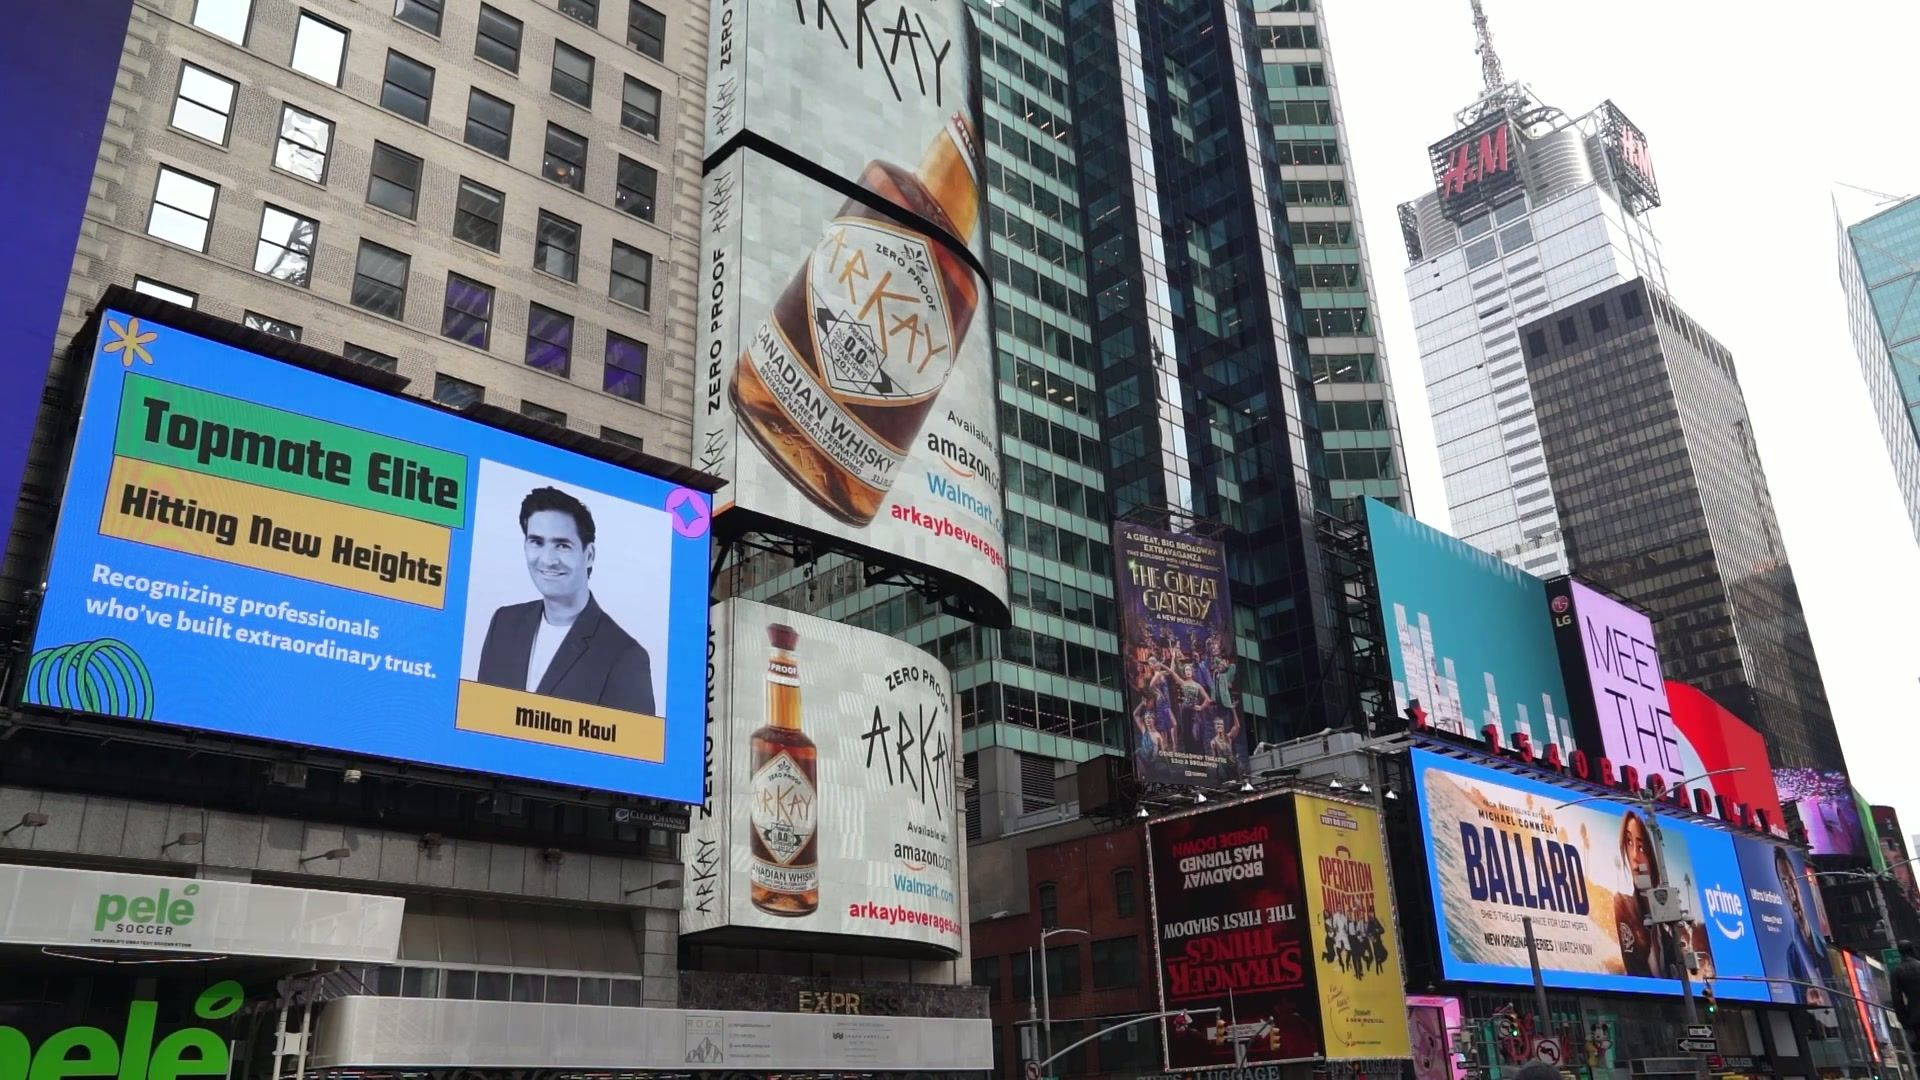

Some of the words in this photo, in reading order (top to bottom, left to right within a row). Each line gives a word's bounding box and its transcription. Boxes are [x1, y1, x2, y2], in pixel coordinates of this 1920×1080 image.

[720, 9, 732, 71] ZERO
[795, 0, 951, 107] KAY
[1442, 124, 1508, 198] H&M
[711, 249, 725, 333] PROOF
[875, 243, 906, 267] ZERO
[907, 267, 937, 312] PROOF
[824, 228, 947, 374] ARKAY
[848, 324, 875, 355] PREMIUM
[708, 339, 722, 416] ZERO
[831, 339, 868, 380] ESTABLISHED
[835, 355, 855, 379] 2011
[757, 324, 828, 421] CANADIAN
[831, 415, 895, 474] WHISKY
[764, 361, 797, 401] ALCOHOL
[795, 399, 815, 422] FREE
[814, 421, 866, 468] ALTERNATIVE
[759, 367, 788, 405] BEVERAGE
[786, 402, 828, 446] NATURALLY
[825, 443, 862, 475] FLAVORED
[947, 410, 993, 451] Available
[142, 396, 352, 487] Topmate
[366, 453, 459, 511] Elite
[700, 428, 728, 476] KAY
[120, 483, 238, 547] Hitting
[249, 514, 321, 560] New
[332, 534, 443, 588] Heights
[1143, 544, 1202, 562] EXTRAVAGANZA
[1161, 539, 1175, 547] BIG
[1176, 541, 1217, 557] BROADWAY
[1130, 564, 1161, 589] THE
[1164, 570, 1217, 599] GREAT
[91, 563, 238, 618] Recognizing
[241, 594, 380, 640] professionals
[1143, 589, 1212, 620] GATSBY
[86, 596, 172, 632] who've
[177, 608, 232, 641] built
[234, 623, 381, 671] extraordinary
[384, 650, 437, 680] trust.
[1555, 615, 1572, 627] LG
[1586, 615, 1666, 697] MEET
[885, 666, 919, 692] ZERO
[922, 669, 949, 714] PROOF
[578, 718, 616, 742] Kaul
[1604, 687, 1684, 776] THE
[861, 703, 953, 821] ARKAY
[1482, 724, 1589, 779] 1540
[907, 821, 940, 840] Available
[1218, 826, 1268, 848] UPSIDE
[1478, 809, 1516, 826] MICHAEL
[1518, 818, 1558, 835] CONNELLY
[894, 843, 952, 872] amazon.com
[1173, 839, 1216, 857] DOWN
[1180, 851, 1232, 872] TURNED
[1234, 843, 1264, 861] HAS
[692, 838, 719, 916] ARKAY
[752, 863, 786, 882] ANADIAN
[1183, 860, 1264, 890] BROADWAY
[1318, 855, 1374, 893] OPERATION
[1460, 821, 1590, 916] BALLARD
[894, 874, 954, 904] Walmart.com
[1705, 883, 1743, 918] prime
[116, 923, 173, 936] SOCCER
[1164, 916, 1219, 939] SHADOW
[1222, 909, 1261, 930] FIRST
[1266, 903, 1296, 923] THE
[1185, 928, 1277, 965] THINGS
[1484, 932, 1500, 946] NEW
[1501, 934, 1528, 949] ORIGINA
[1535, 938, 1554, 952] ERIES
[1560, 941, 1579, 954] WATCH
[1579, 943, 1593, 956] NOW
[1167, 947, 1303, 995] STRANGER
